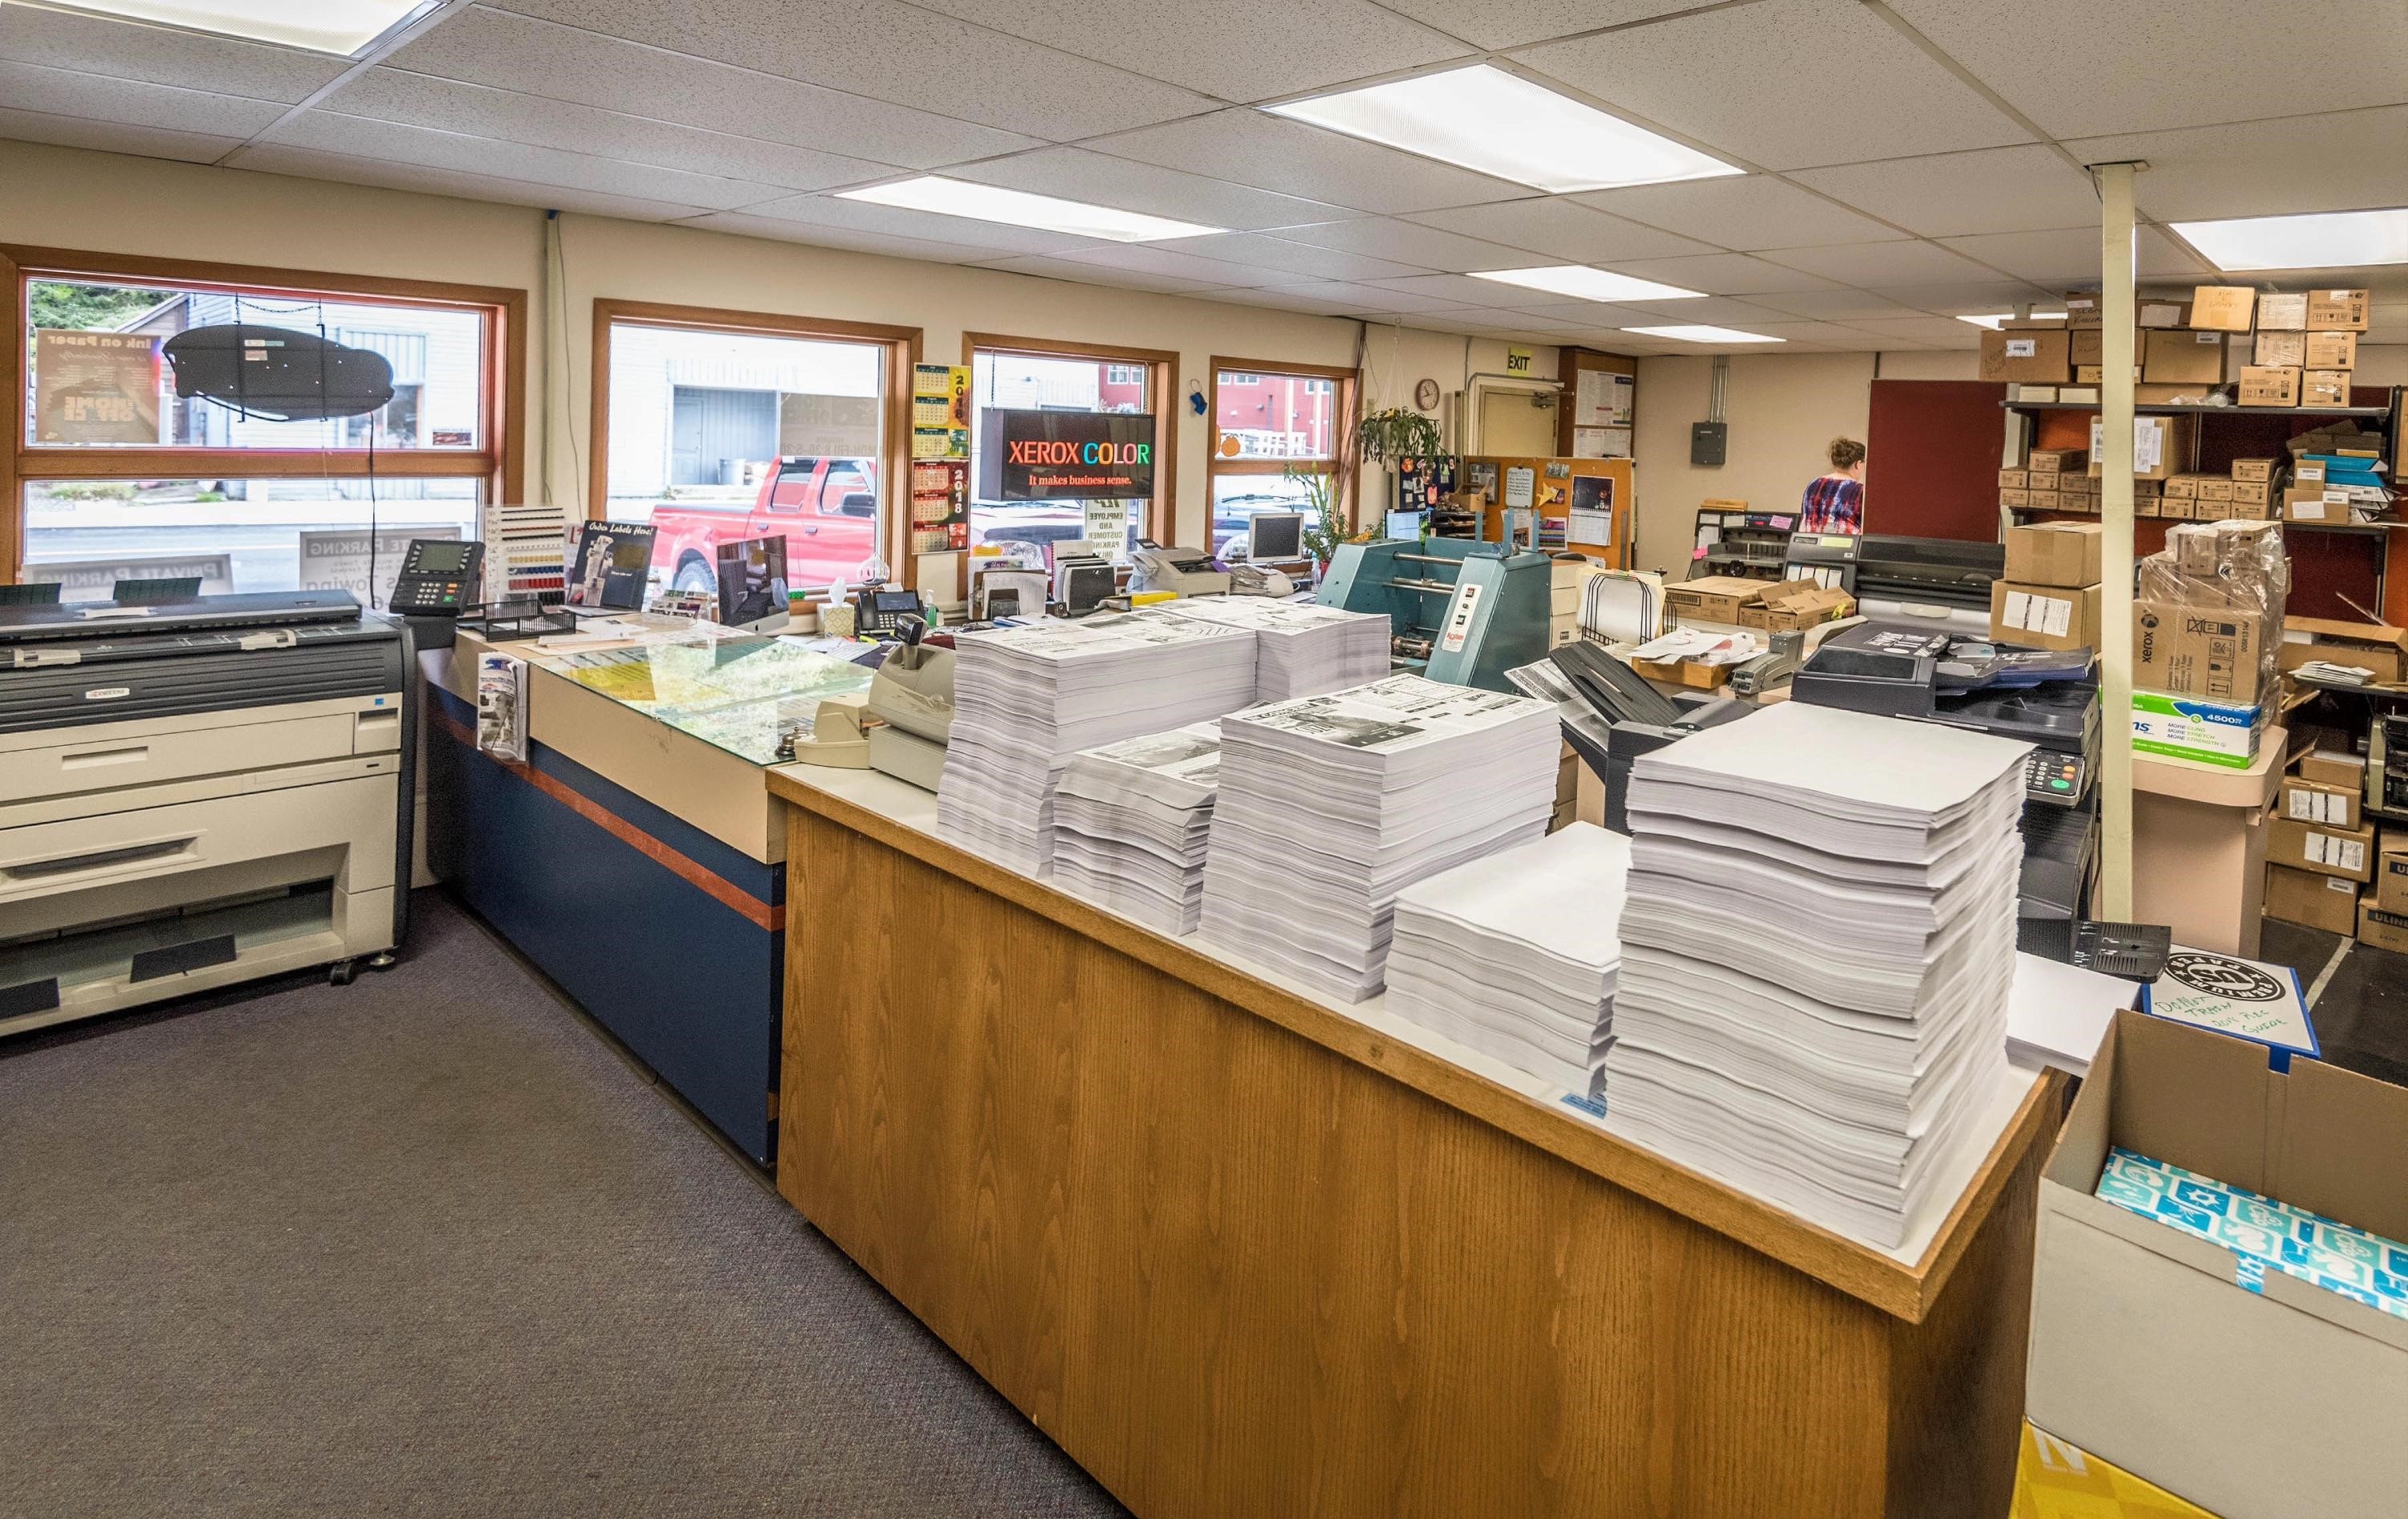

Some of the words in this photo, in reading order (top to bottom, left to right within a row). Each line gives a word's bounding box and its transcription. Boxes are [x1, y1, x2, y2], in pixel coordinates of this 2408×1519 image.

[1508, 355, 1531, 371] EXIT
[1009, 441, 1080, 464] XEROX
[1084, 442, 1150, 465] COLOR
[1028, 475, 1037, 485] It
[1039, 475, 1068, 485] makes
[1069, 475, 1105, 486] business
[1107, 477, 1132, 485] sense.
[954, 470, 963, 514] 2018
[589, 522, 608, 531] Order
[609, 523, 632, 534] Labels
[633, 527, 653, 536] Here!
[2142, 631, 2154, 664] xerox
[2207, 715, 2235, 723] 4500
[2133, 722, 2151, 731] ns
[2186, 731, 2215, 739] STRETCH
[2186, 737, 2219, 747] STRENGTH
[2376, 914, 2408, 927] ULINE
[2170, 956, 2240, 970] PAPER
[2189, 968, 2254, 983] US
[2190, 979, 2273, 997] PREMIUM
